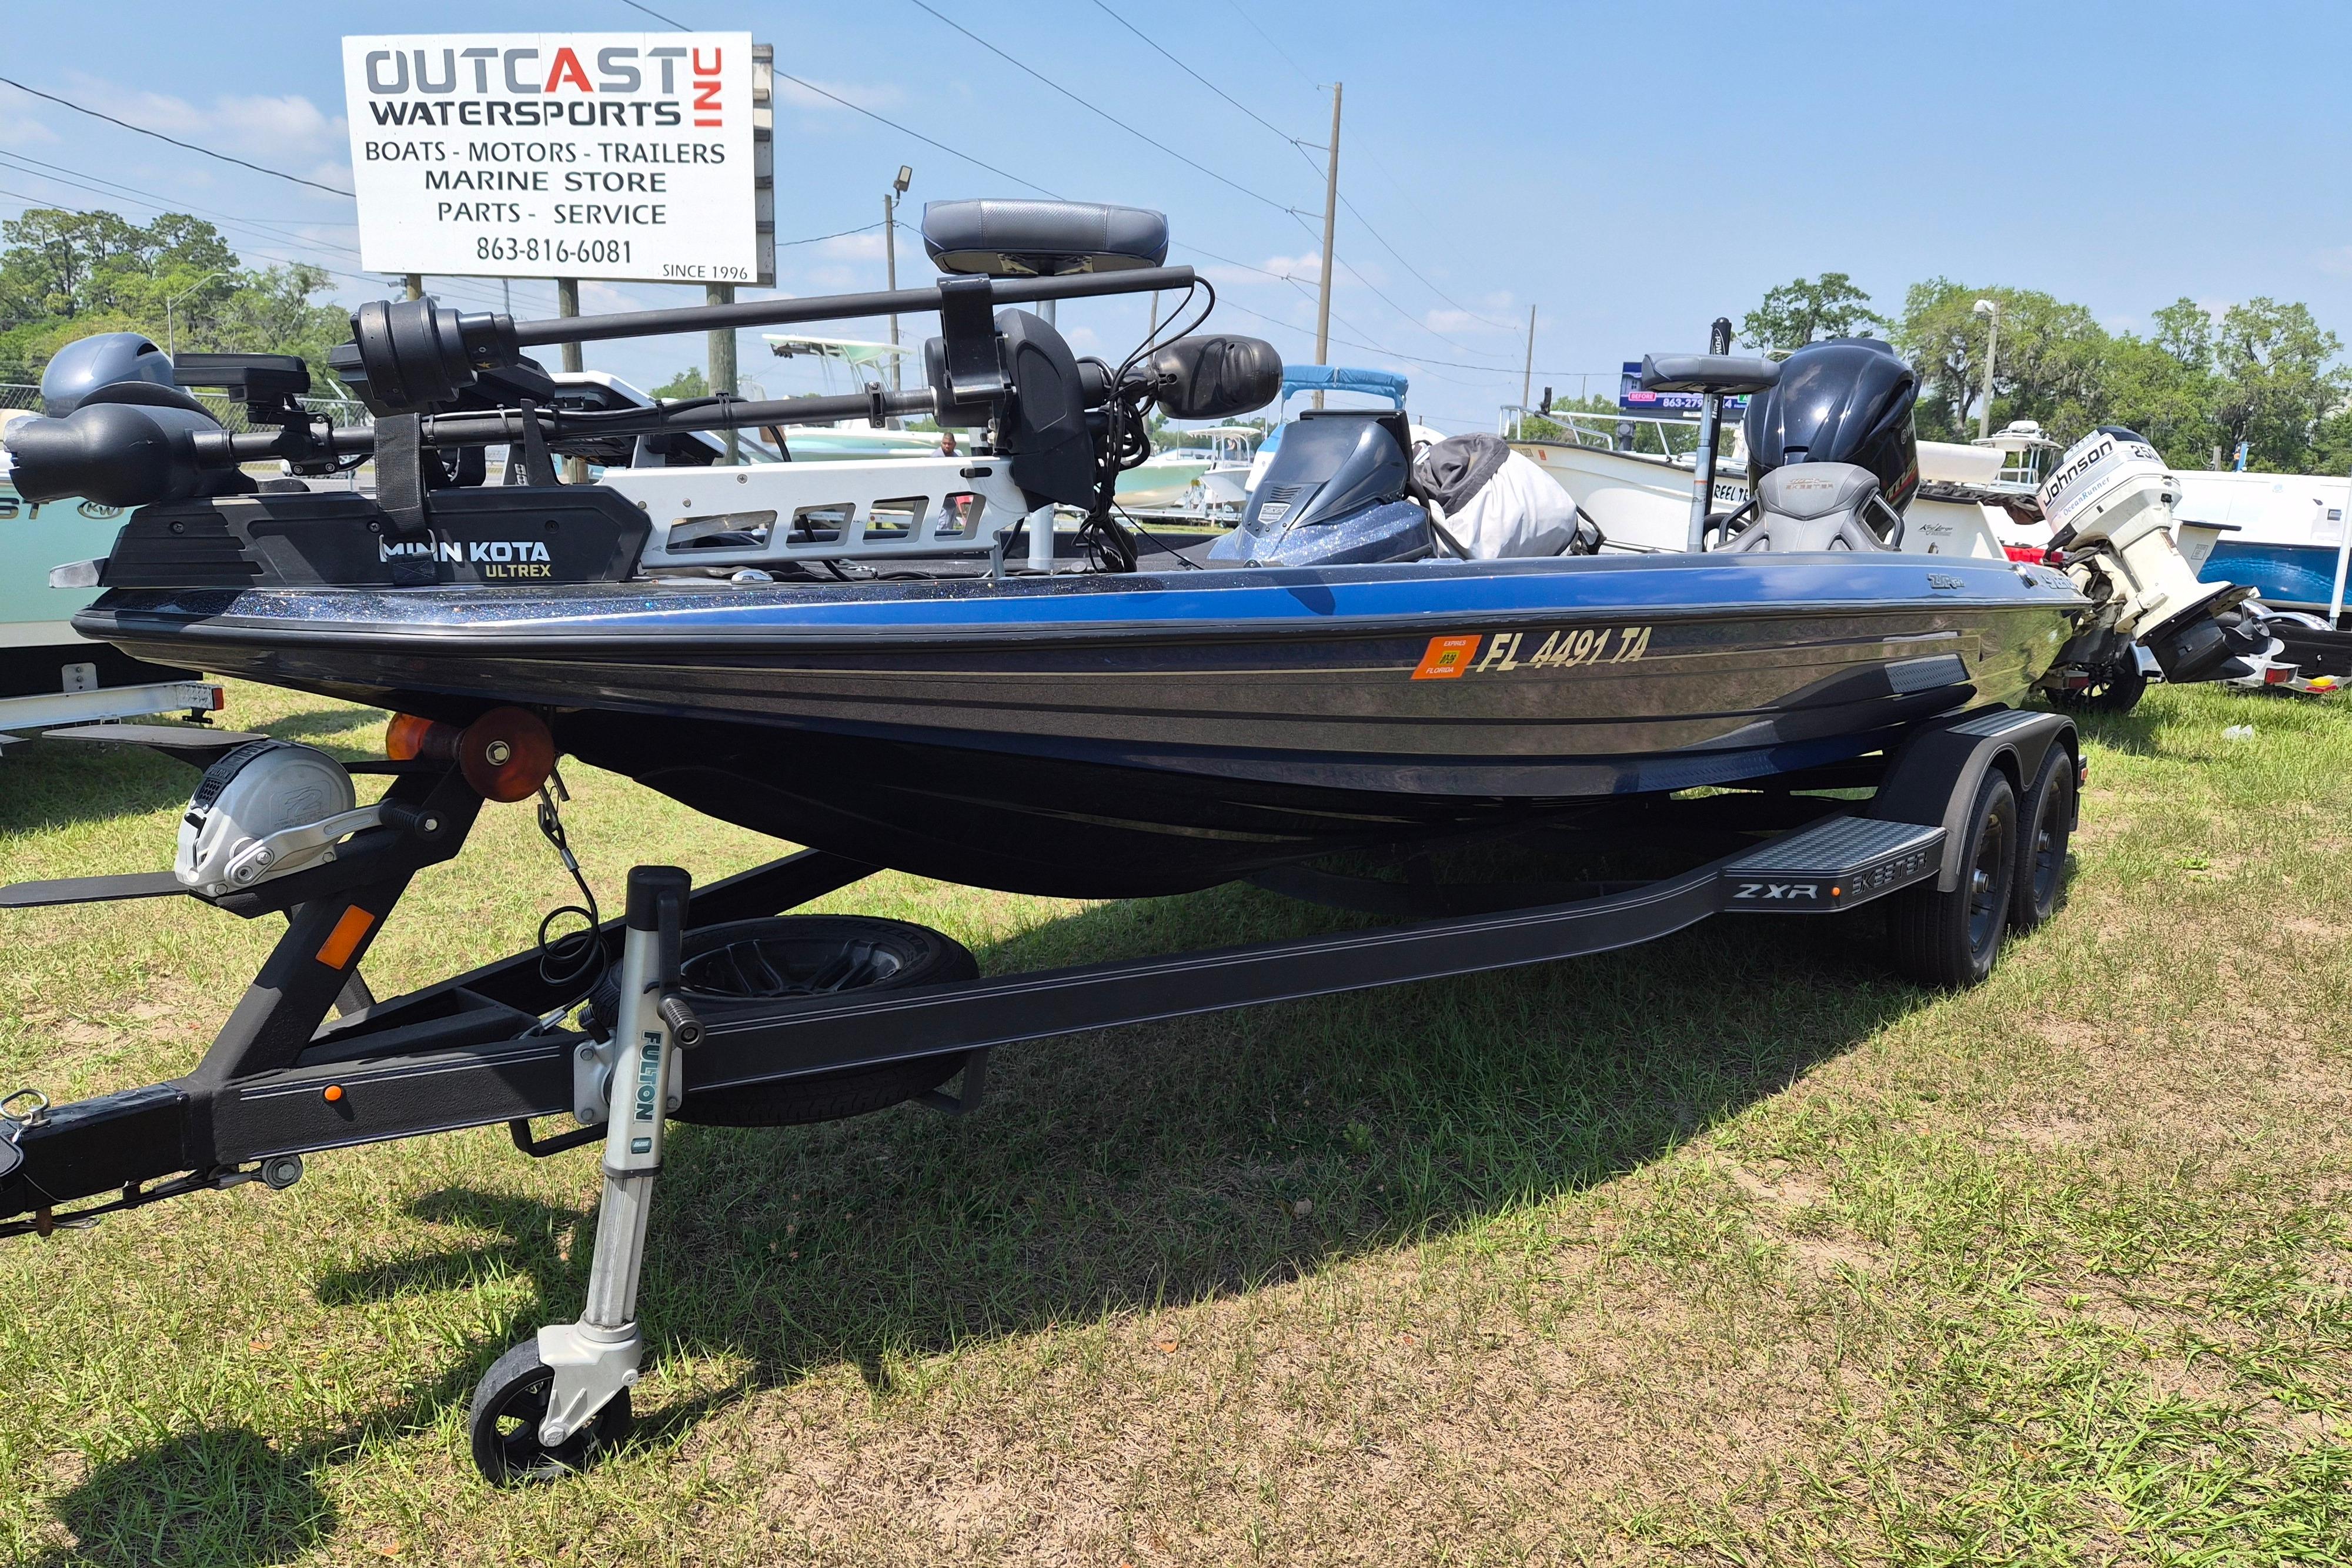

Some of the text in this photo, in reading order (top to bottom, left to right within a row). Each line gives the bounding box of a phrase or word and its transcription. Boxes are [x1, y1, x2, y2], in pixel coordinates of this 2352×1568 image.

[366, 48, 687, 94] OUTCAST
[693, 48, 722, 127] INC
[369, 101, 681, 127] WATERSPORTS
[365, 141, 446, 162] BOATS
[469, 142, 576, 163] MOTORS
[597, 143, 725, 164] TRAILERS
[425, 170, 667, 192] MARINE STORE
[438, 203, 520, 222] PARTS
[554, 203, 667, 225] SERVICE
[476, 237, 631, 263] 863-816-6081
[663, 263, 748, 280] SINCE 1996
[2130, 445, 2159, 462] 250
[2043, 441, 2113, 506] Johnson
[1713, 484, 1736, 501] REEL
[470, 541, 550, 562] KOTA
[485, 564, 552, 577] ULTREX
[1475, 627, 1652, 673] FL 4491 TA
[1852, 851, 1927, 897] SKEETER
[1732, 884, 1819, 899] ZXR
[633, 1030, 663, 1122] FULTON
